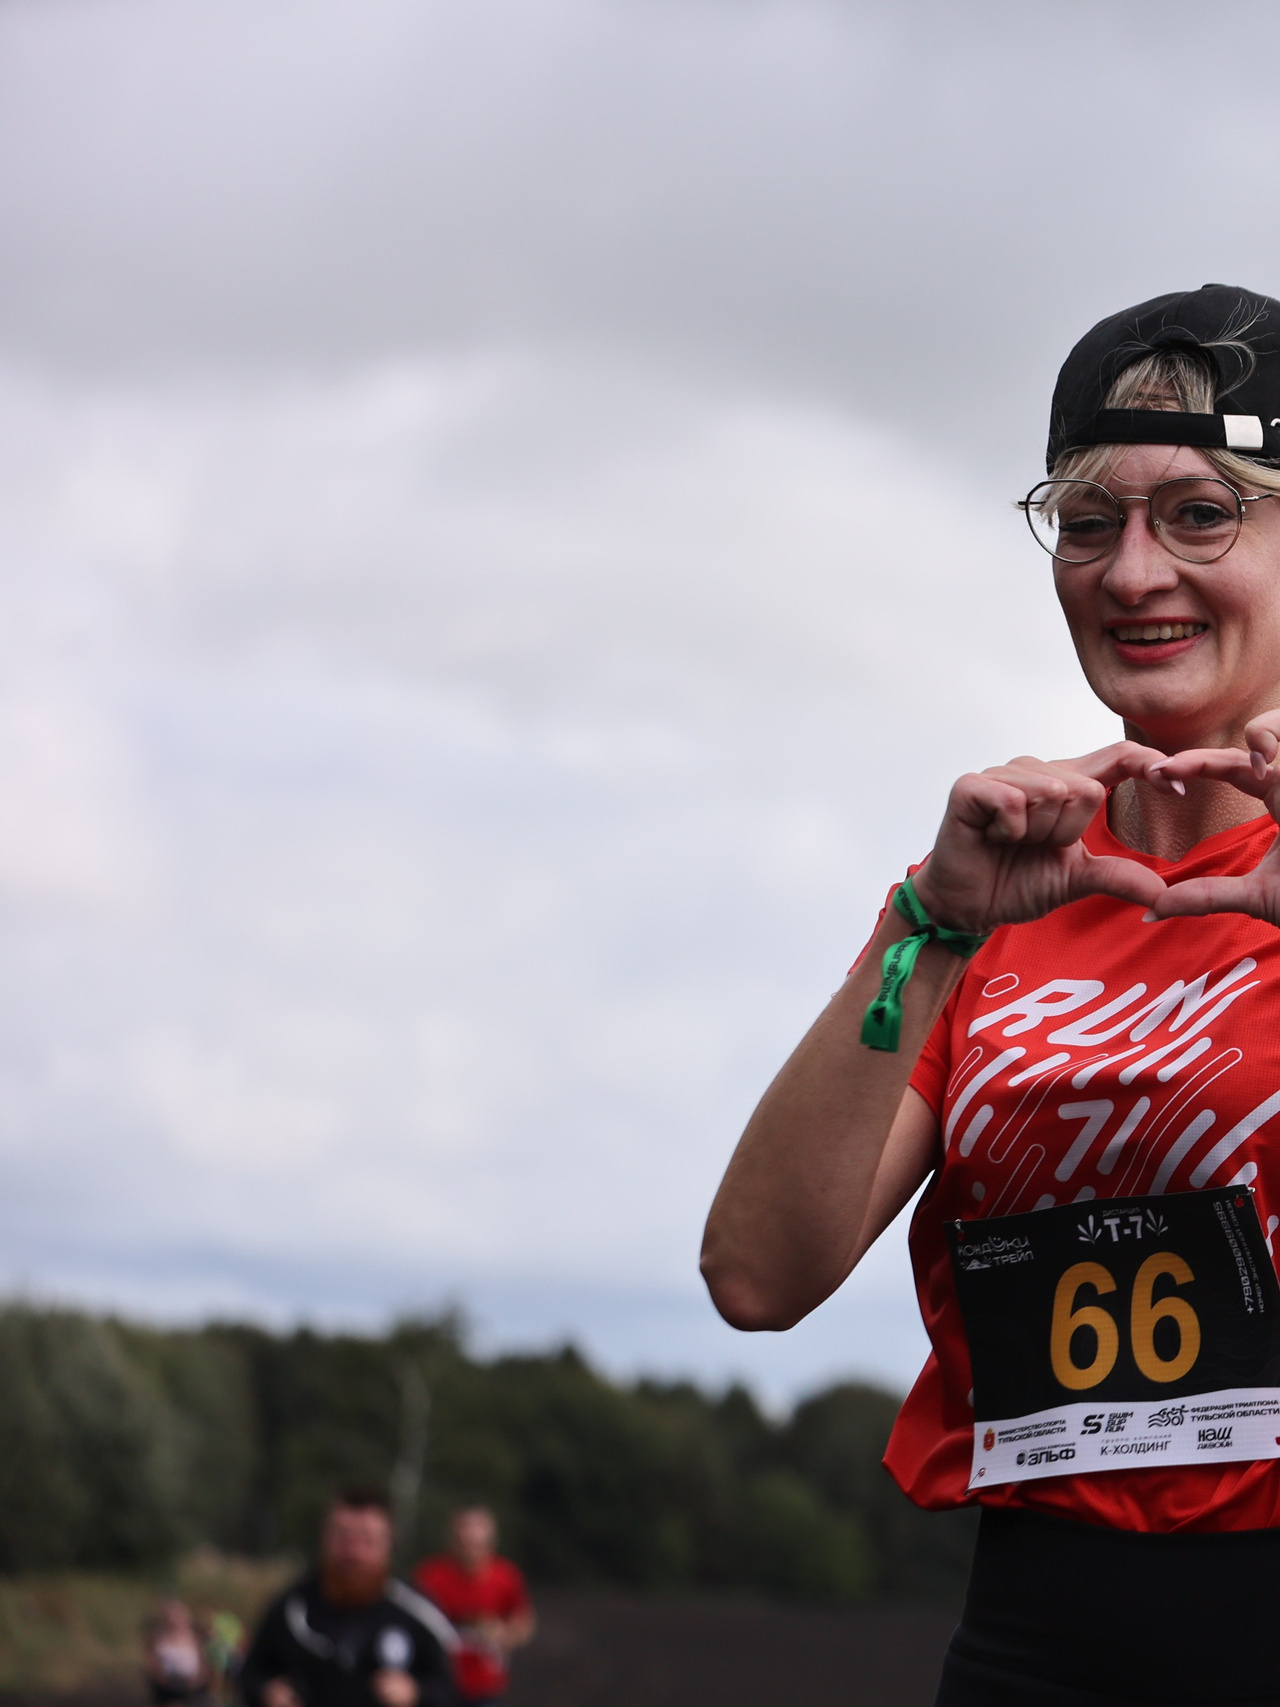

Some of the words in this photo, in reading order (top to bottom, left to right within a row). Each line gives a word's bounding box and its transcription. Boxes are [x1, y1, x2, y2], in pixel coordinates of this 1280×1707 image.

[967, 957, 1258, 1047] RUN
[992, 1249, 1035, 1266] ТРЕЙЛ
[1050, 1251, 1201, 1390] 66
[1190, 1403, 1234, 1413] ФЕДЕРАЦИЯ
[1234, 1399, 1279, 1409] ТРИАТЛОНА
[1190, 1409, 1235, 1423] ТУЛЬСКОЙ
[1236, 1407, 1280, 1418] ОБЛАСТИ
[1100, 1440, 1172, 1456] К-ХОЛДИНГ
